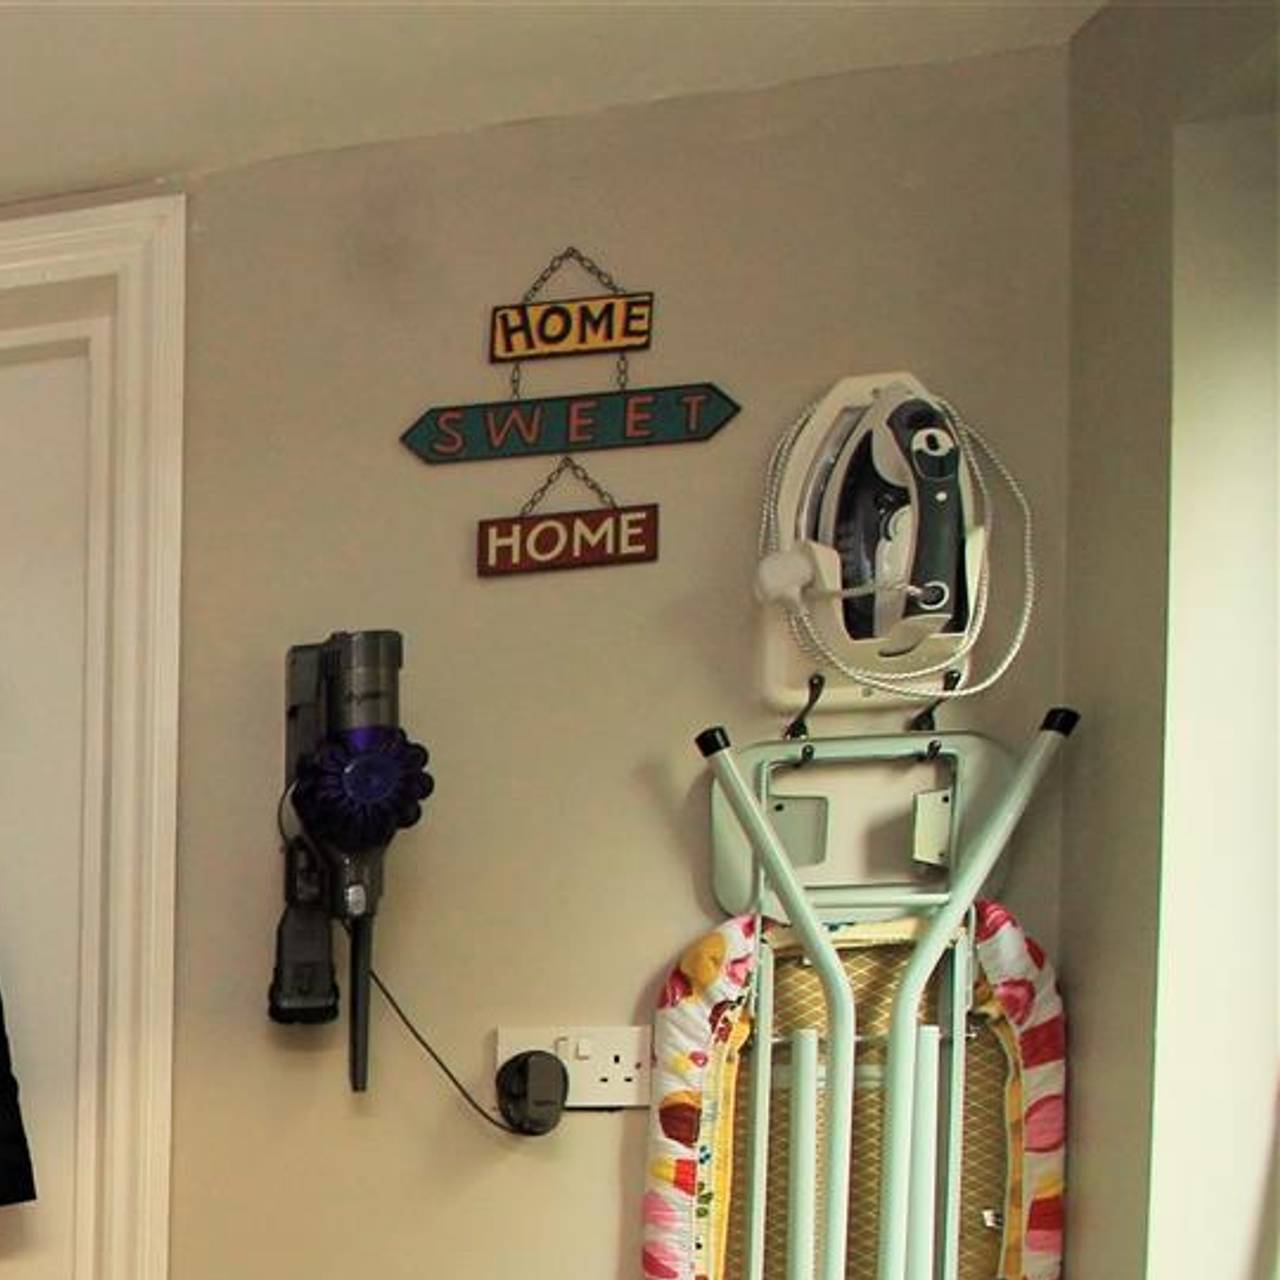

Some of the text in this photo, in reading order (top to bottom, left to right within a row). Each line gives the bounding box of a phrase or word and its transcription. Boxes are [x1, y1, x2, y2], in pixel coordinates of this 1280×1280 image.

[498, 301, 650, 353] HOME
[433, 394, 708, 455] SWEET
[487, 512, 647, 567] HOME
